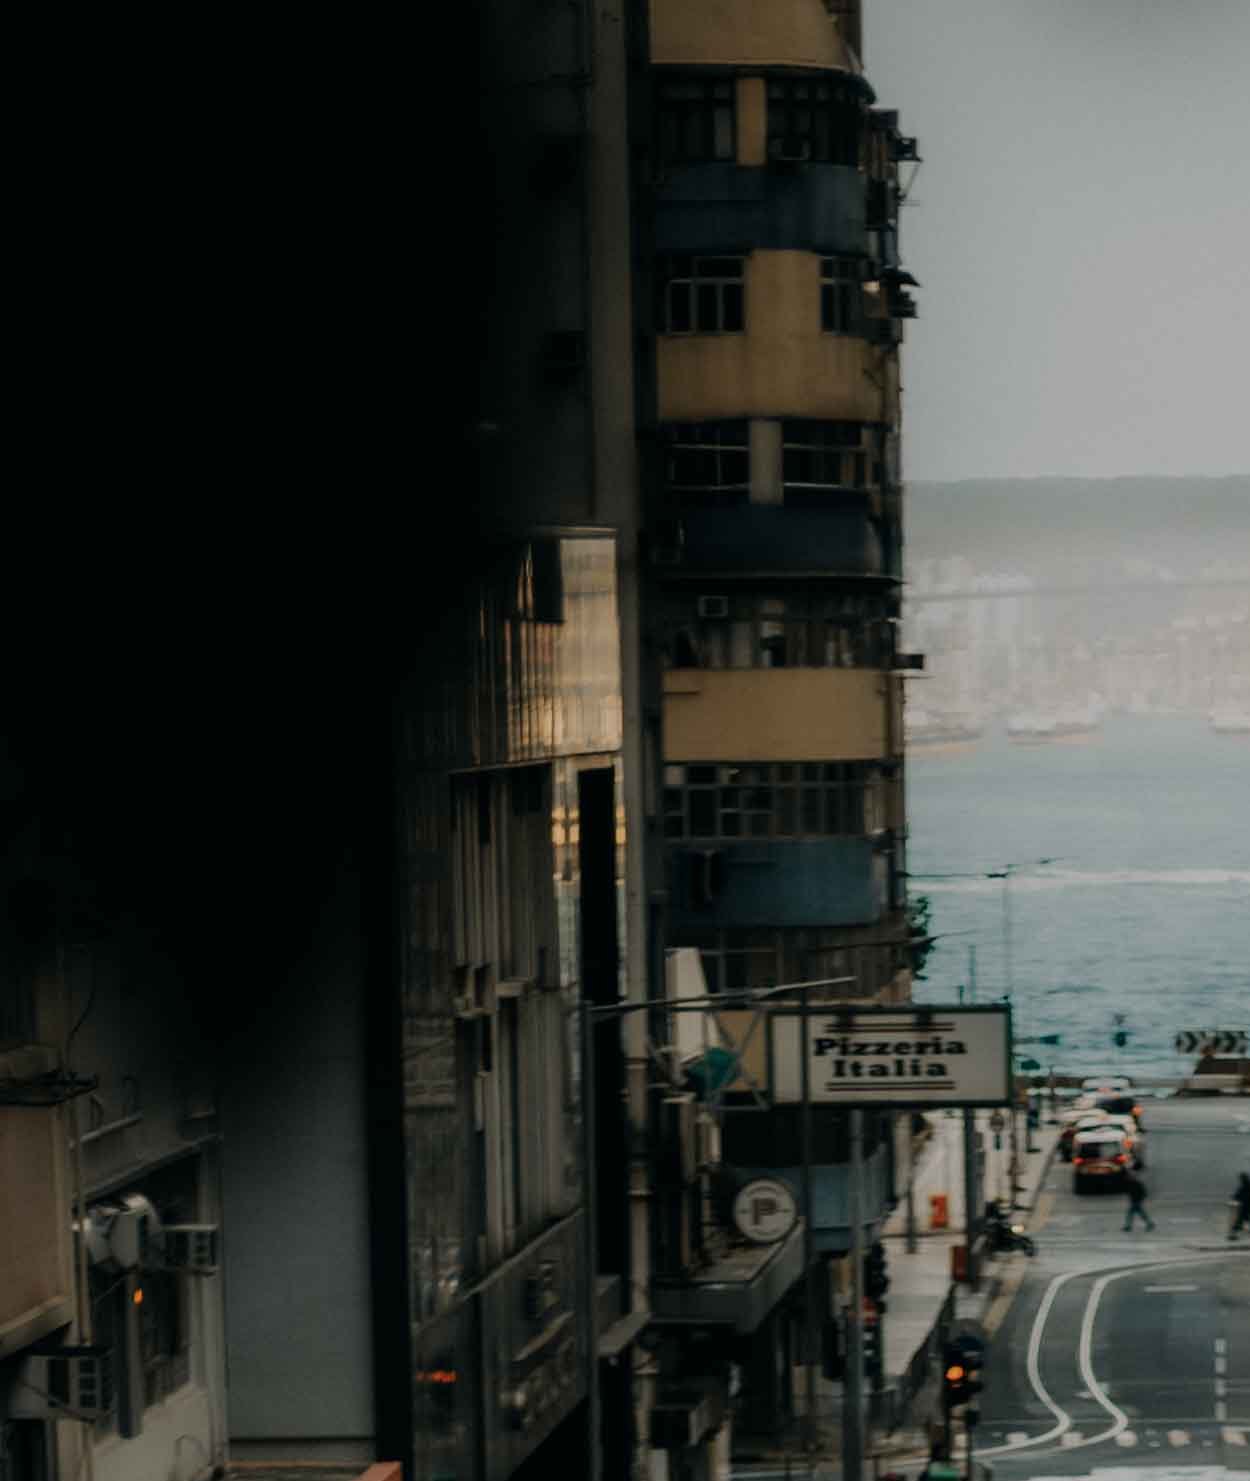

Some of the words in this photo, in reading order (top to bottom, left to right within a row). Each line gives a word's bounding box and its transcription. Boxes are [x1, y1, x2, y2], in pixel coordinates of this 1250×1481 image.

[814, 1037, 968, 1056] Pizzeria
[834, 1059, 948, 1077] Italia
[753, 1198, 776, 1224] P
